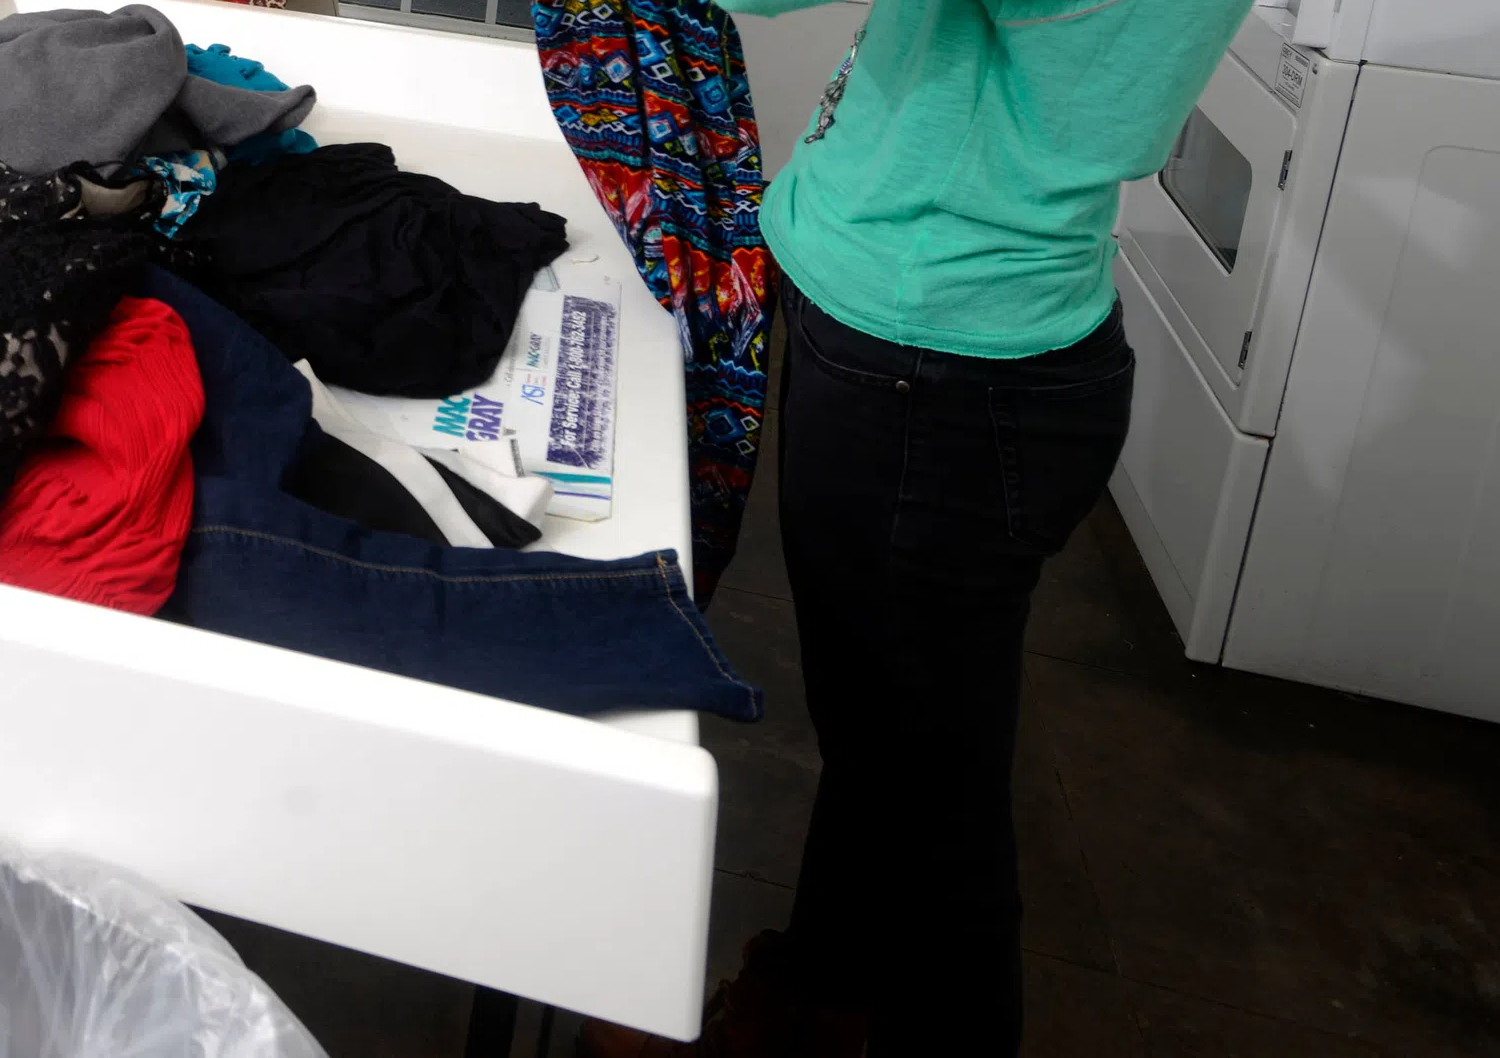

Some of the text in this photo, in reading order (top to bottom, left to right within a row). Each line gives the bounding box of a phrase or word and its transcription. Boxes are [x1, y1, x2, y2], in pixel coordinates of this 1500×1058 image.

[566, 371, 582, 389] Call
[466, 394, 504, 441] GRAY
[560, 429, 578, 447] For
